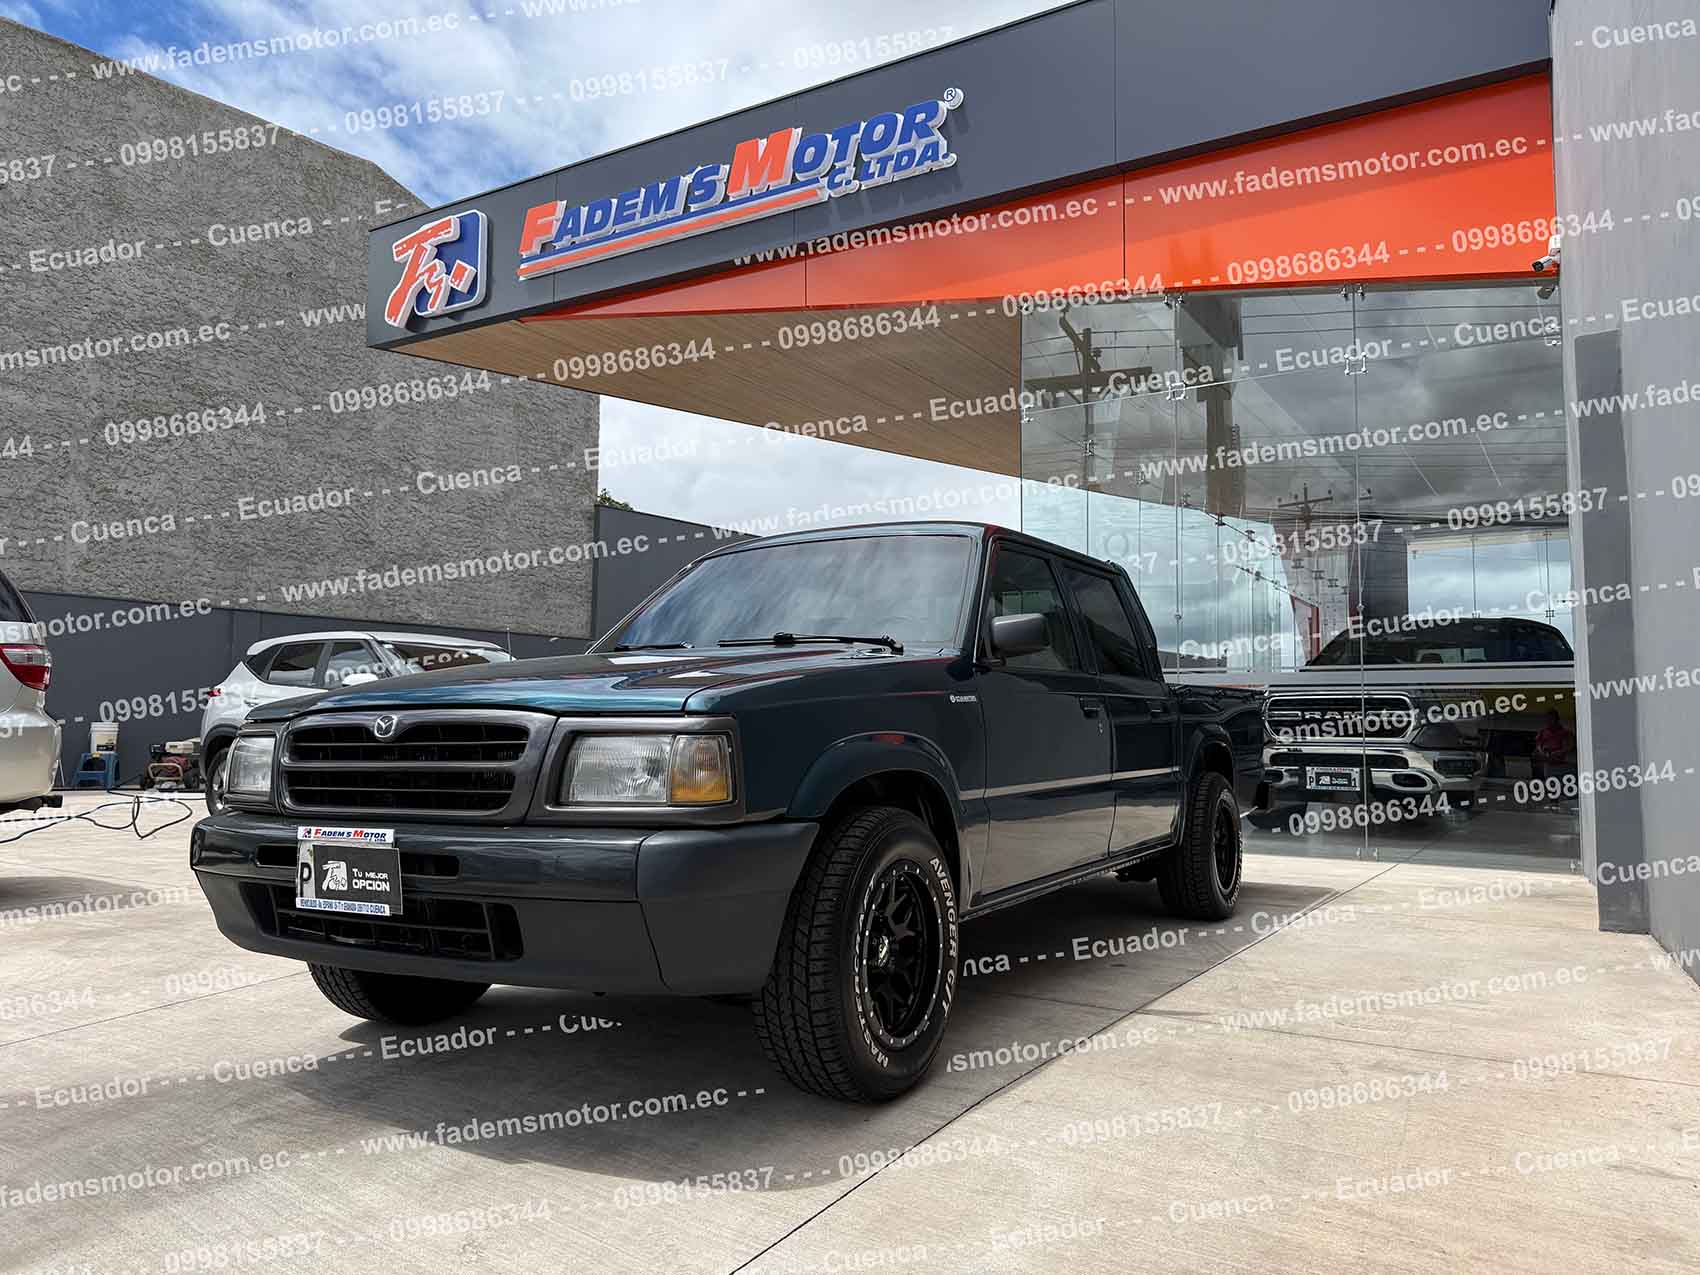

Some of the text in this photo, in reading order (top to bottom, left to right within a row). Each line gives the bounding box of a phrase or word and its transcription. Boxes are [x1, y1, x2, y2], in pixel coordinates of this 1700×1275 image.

[727, 100, 943, 196] MOTOR
[353, 830, 387, 840] MOTOR
[365, 871, 389, 880] MEJOR
[352, 879, 390, 891] OPCION
[929, 857, 958, 958] AVENGER
